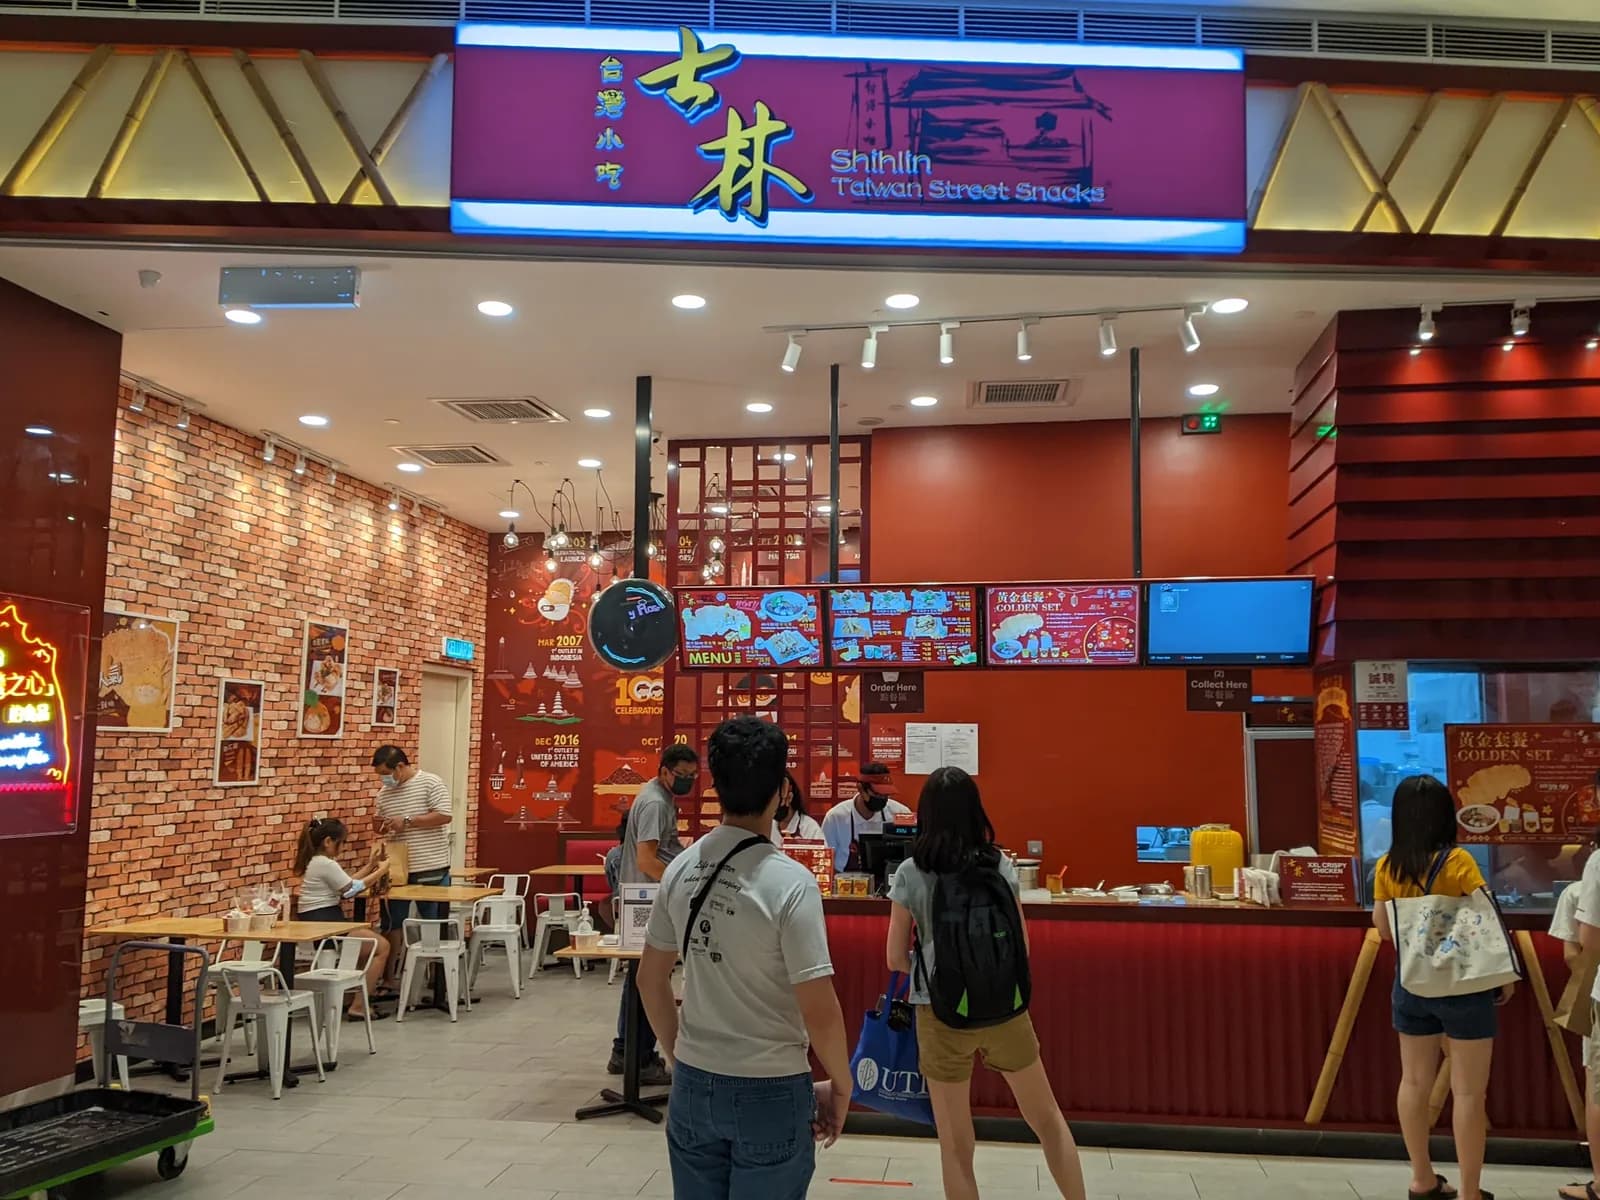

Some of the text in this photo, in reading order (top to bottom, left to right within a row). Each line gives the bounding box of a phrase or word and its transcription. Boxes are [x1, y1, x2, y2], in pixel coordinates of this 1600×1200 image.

[830, 149, 933, 176] Shihlin
[831, 177, 1105, 204] Taiwan Street Snacks
[995, 603, 1062, 612] GOLDEN SET
[556, 634, 584, 646] 2007
[689, 652, 733, 664] MENU
[870, 683, 917, 692] Order Here
[1191, 680, 1248, 689] Collect Here
[535, 734, 580, 746] DEC 2016
[641, 737, 659, 746] OCT
[1457, 750, 1554, 762] GOLDEN SET
